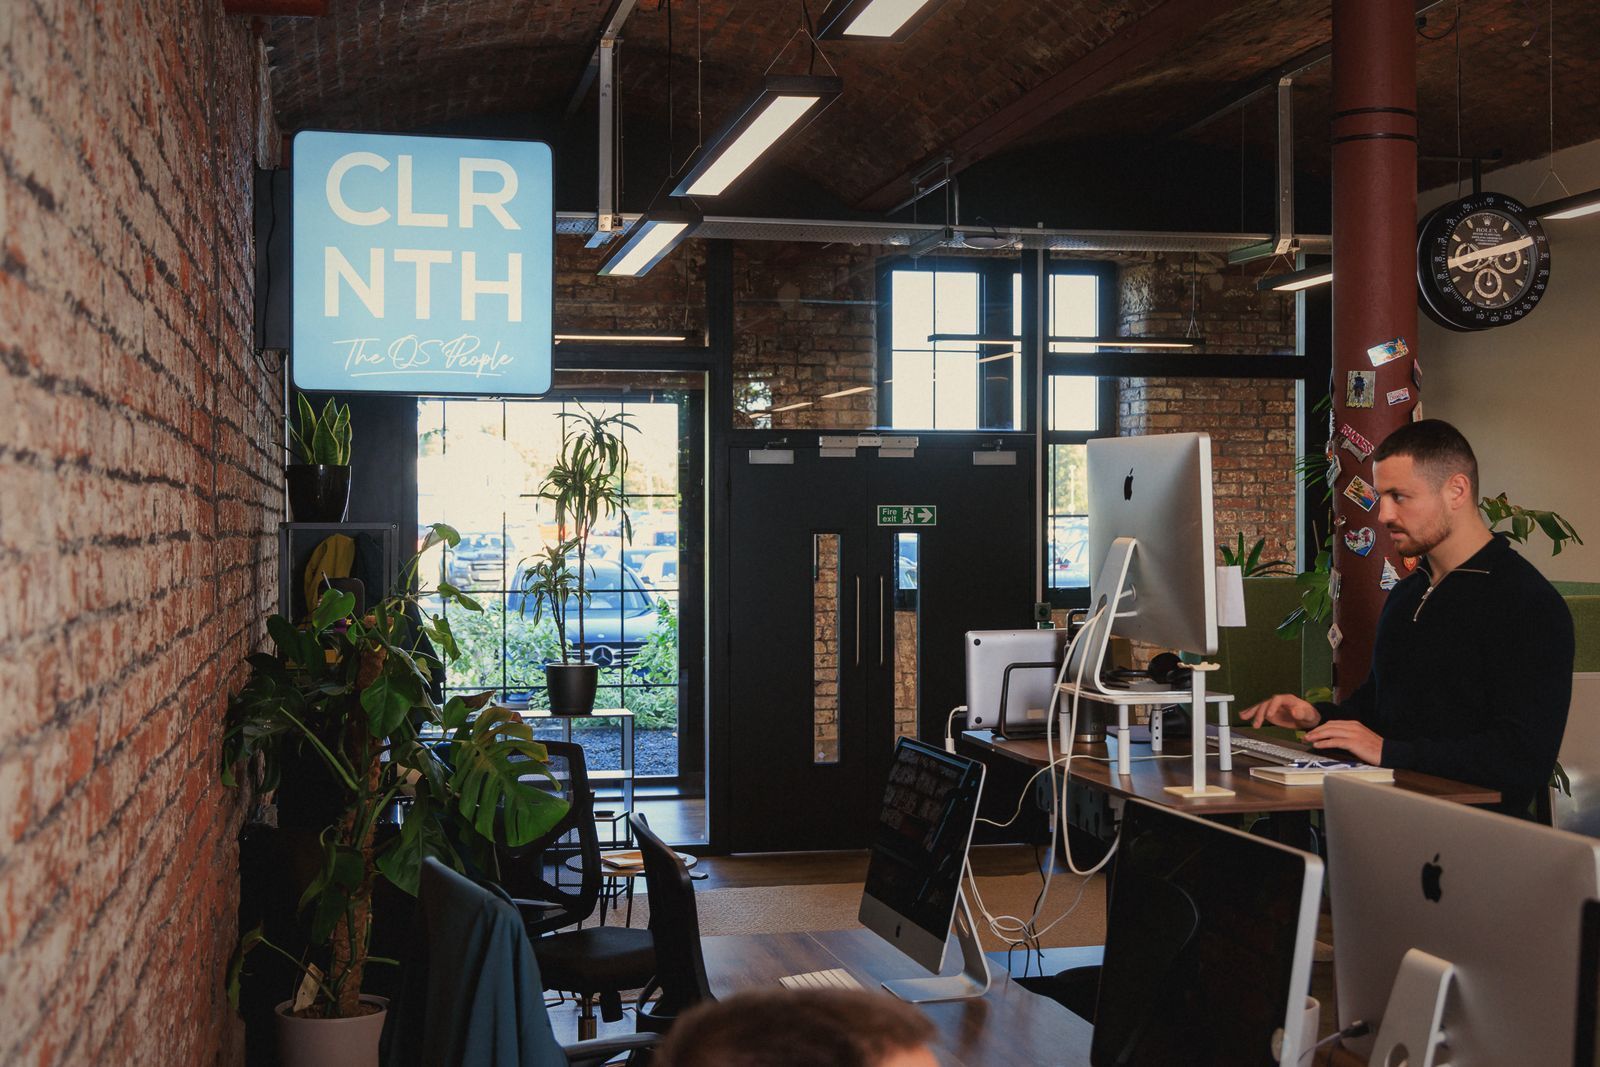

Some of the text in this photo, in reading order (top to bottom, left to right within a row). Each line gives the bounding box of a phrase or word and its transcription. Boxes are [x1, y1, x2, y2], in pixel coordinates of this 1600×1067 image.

[325, 151, 521, 230] CLR
[324, 246, 522, 322] NTH
[332, 333, 514, 378] The QS People
